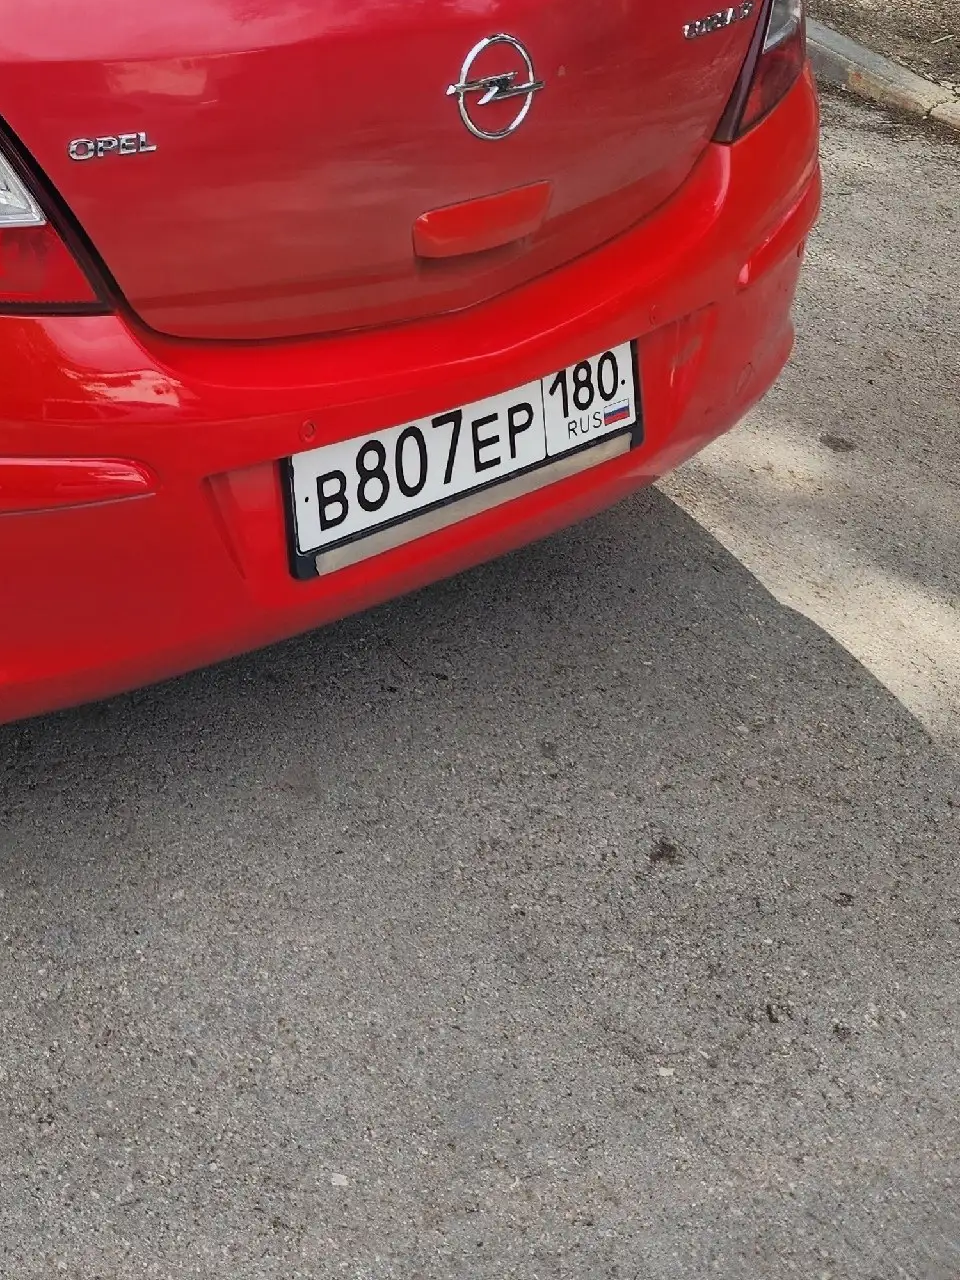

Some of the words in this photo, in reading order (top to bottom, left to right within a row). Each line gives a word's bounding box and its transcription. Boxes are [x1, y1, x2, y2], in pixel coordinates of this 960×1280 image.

[69, 131, 157, 160] OPEL
[548, 350, 619, 419] 180
[567, 410, 603, 439] RUS
